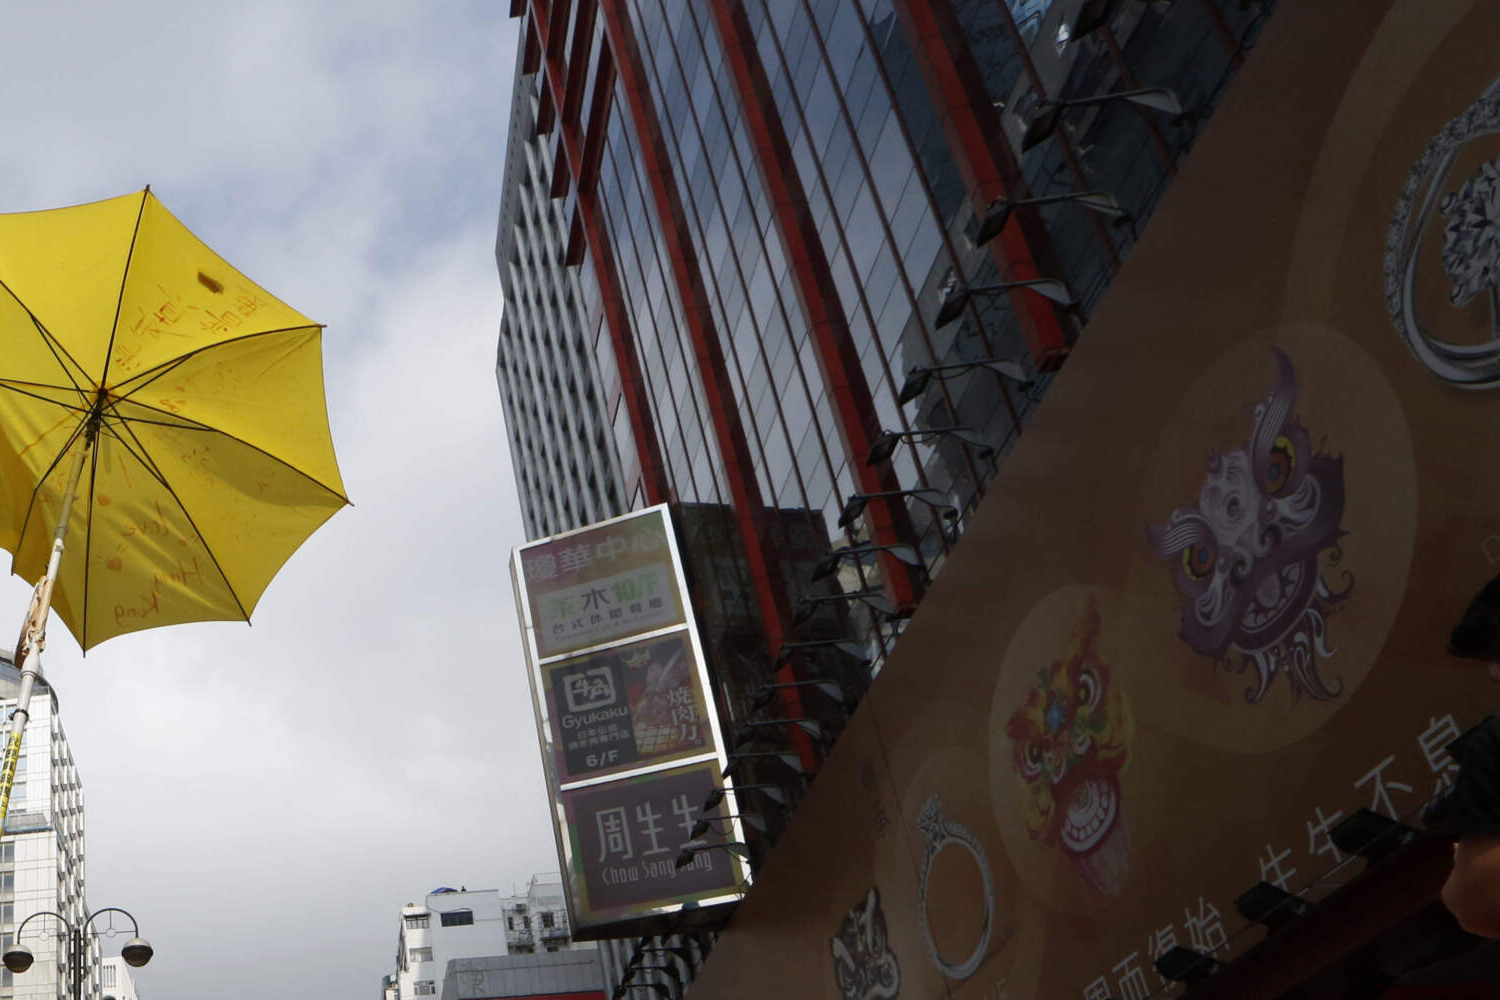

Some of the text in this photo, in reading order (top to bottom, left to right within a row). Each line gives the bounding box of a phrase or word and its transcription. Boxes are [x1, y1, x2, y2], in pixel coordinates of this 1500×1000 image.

[562, 705, 629, 730] Gyukaku
[586, 750, 619, 767] 6/F
[596, 794, 709, 863] 周生生
[602, 865, 639, 887] Chow
[641, 854, 677, 881] Sang
